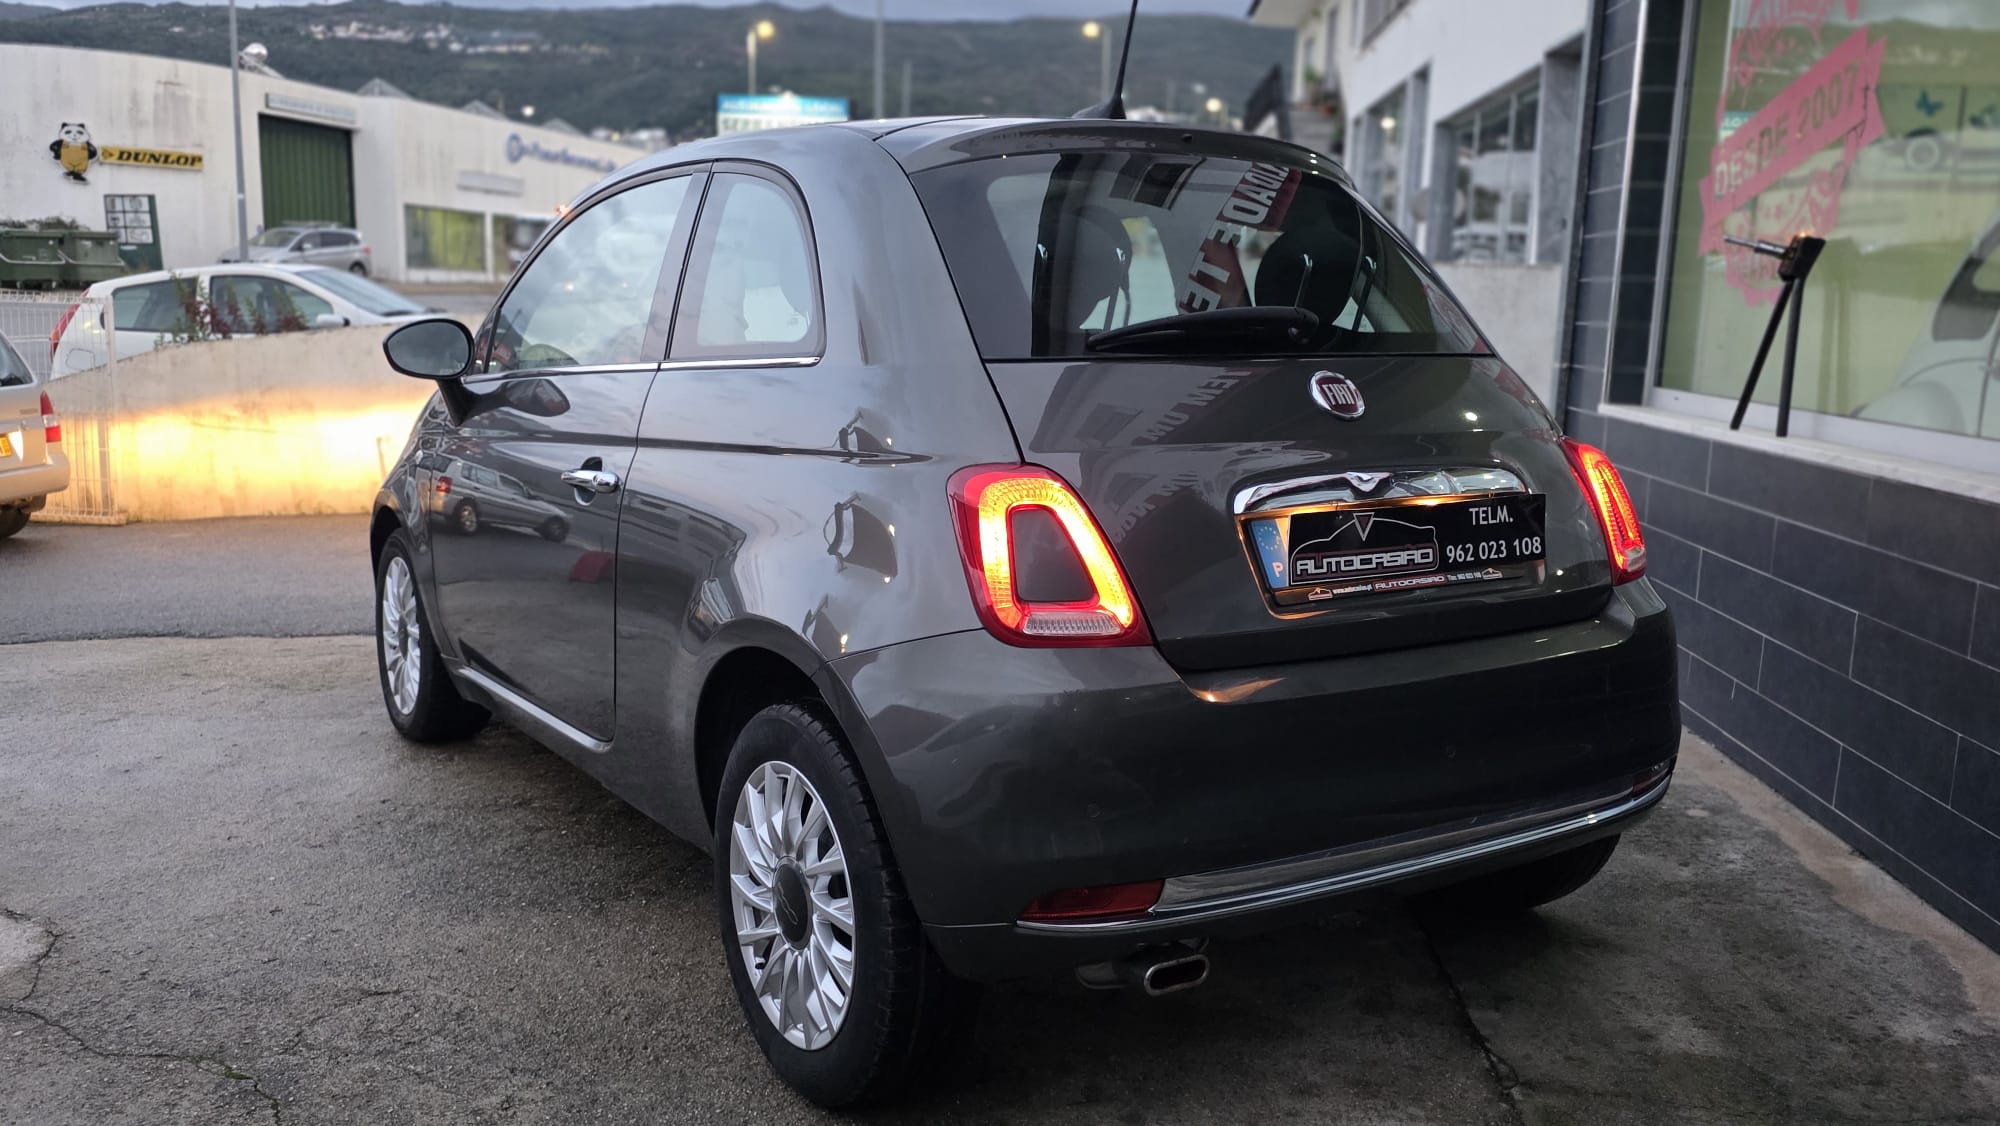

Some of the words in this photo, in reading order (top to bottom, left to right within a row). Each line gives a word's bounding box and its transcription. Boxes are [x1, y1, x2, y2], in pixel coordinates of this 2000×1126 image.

[1714, 112, 1790, 199] DESDE
[1797, 60, 1859, 142] 2007
[117, 151, 203, 166] DUNLOP
[1321, 383, 1356, 405] FIAT
[1469, 505, 1514, 526] TELM.
[1446, 543, 1475, 563] 962
[1479, 540, 1507, 560] 023
[1513, 536, 1542, 557] 108
[1272, 561, 1284, 578] P
